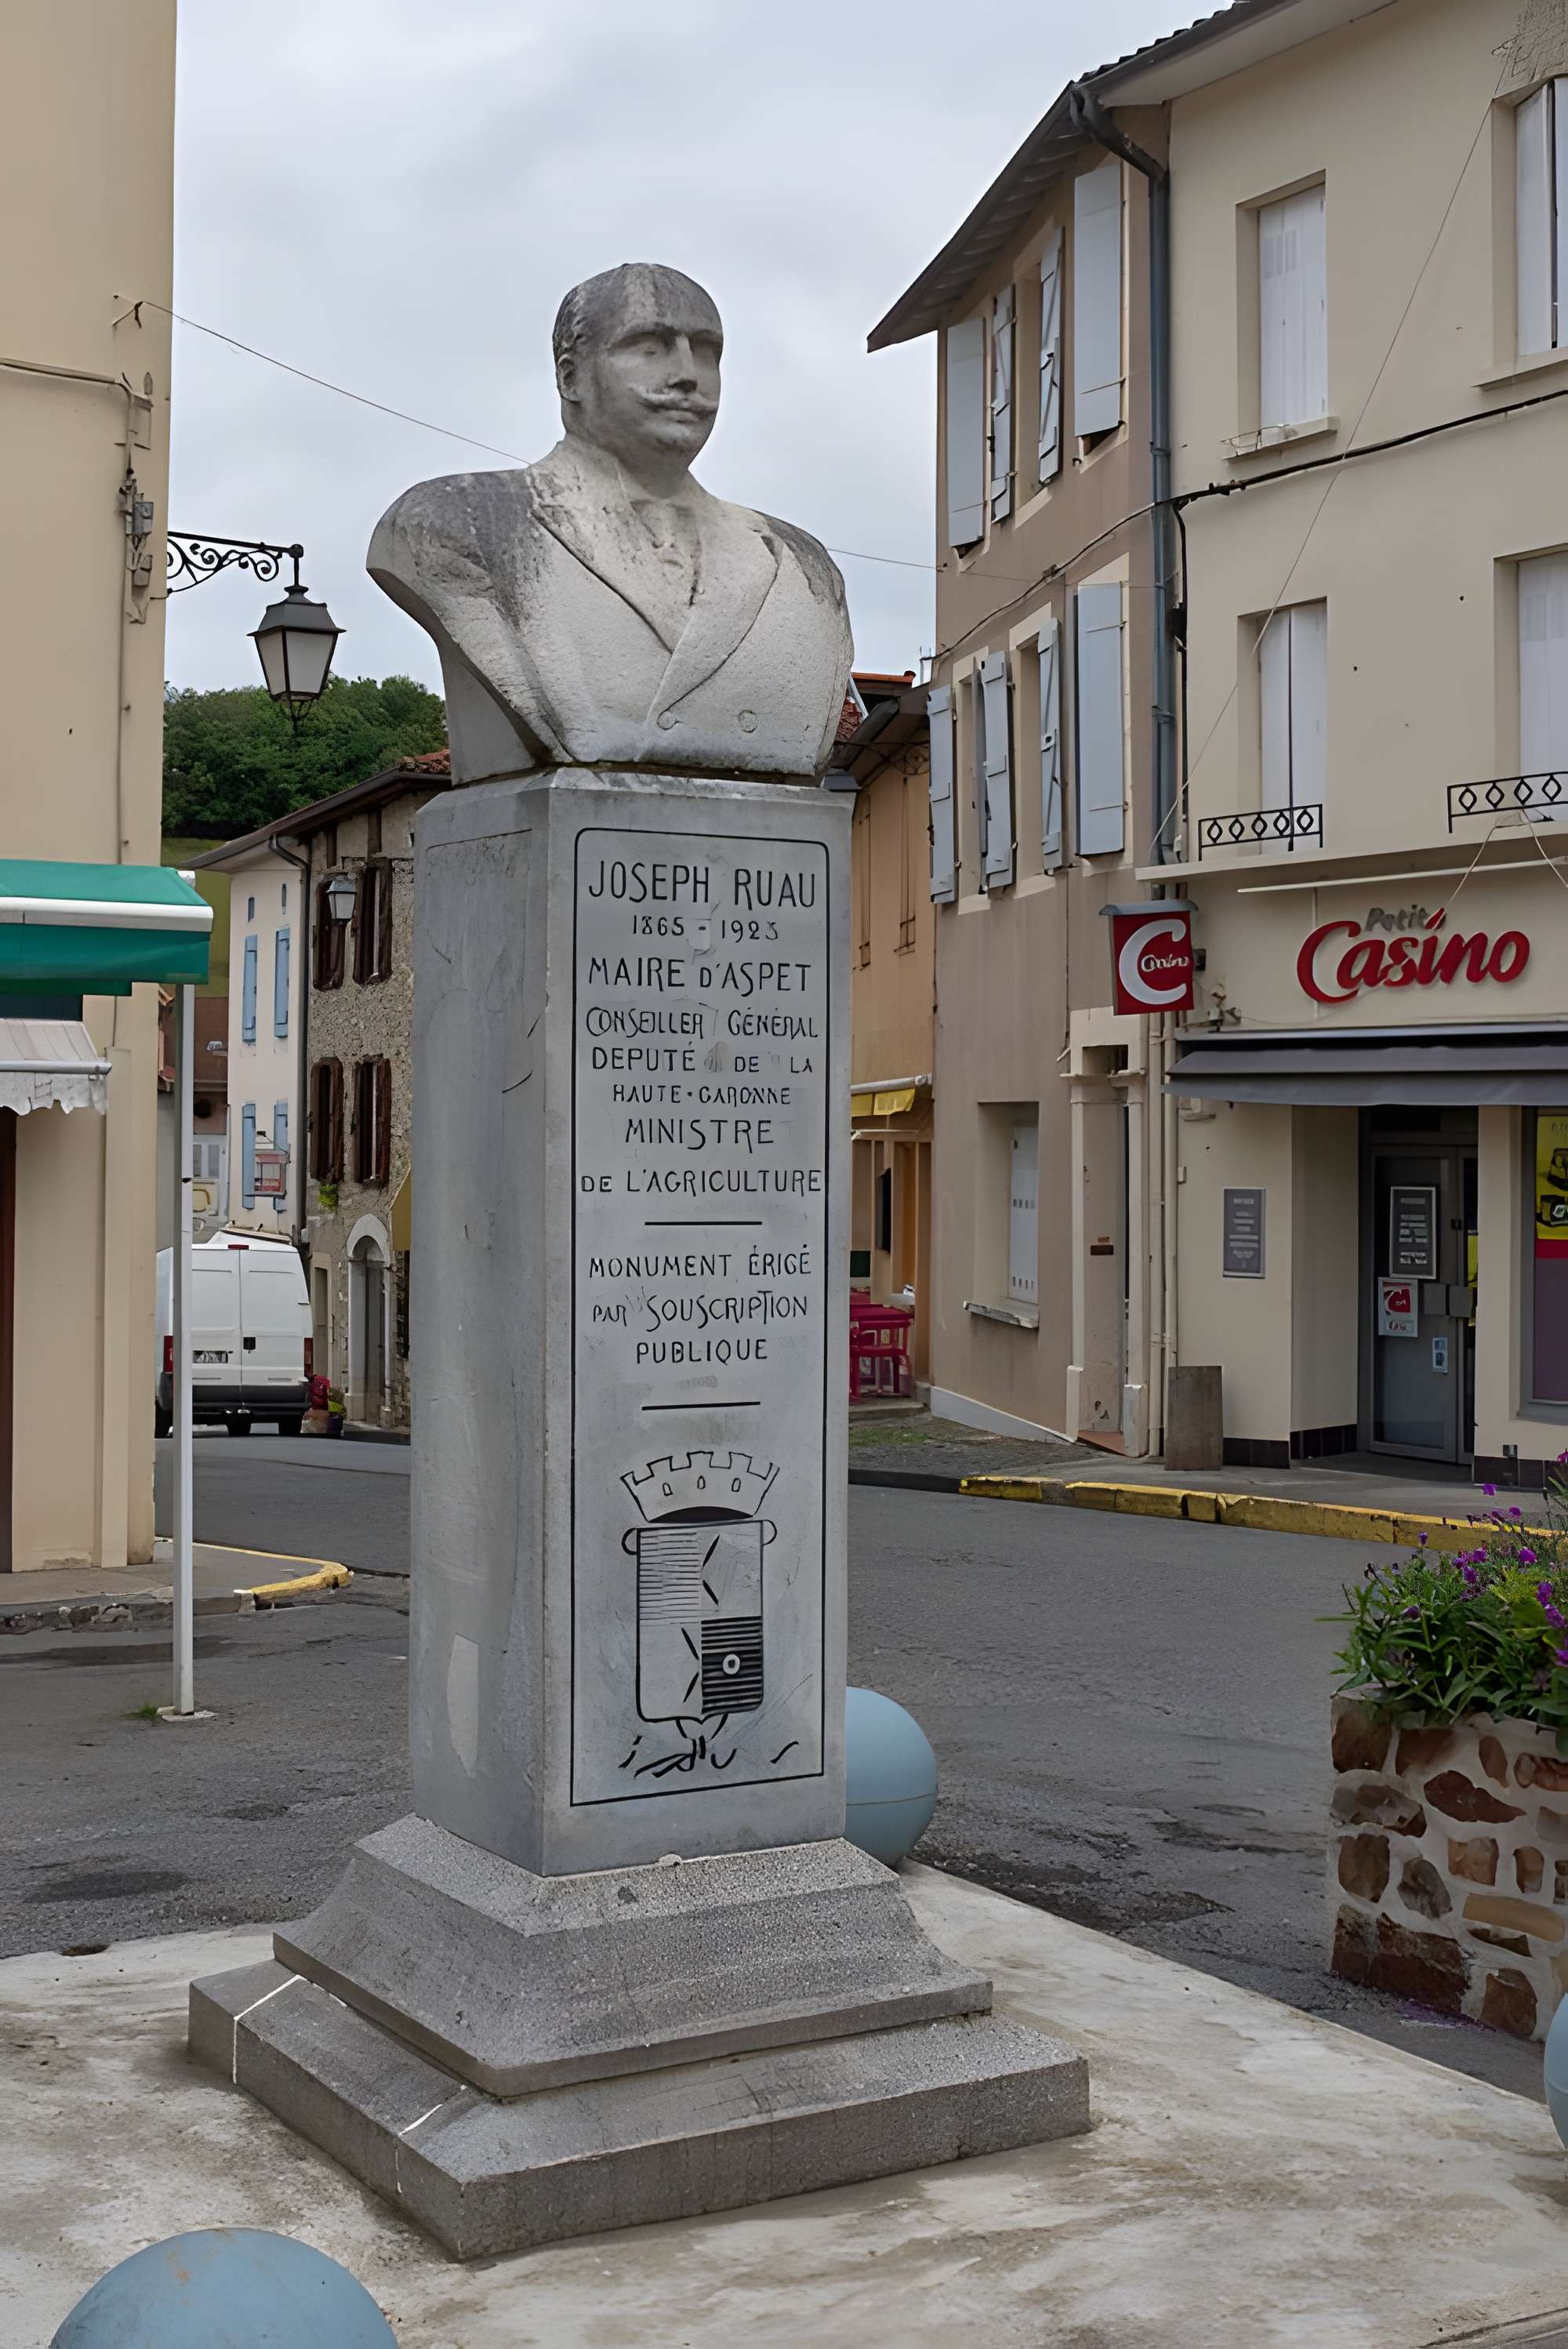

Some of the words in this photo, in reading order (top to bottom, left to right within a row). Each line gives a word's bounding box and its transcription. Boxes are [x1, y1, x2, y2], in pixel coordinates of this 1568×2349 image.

[588, 860, 710, 903] JOSEPH
[734, 868, 815, 911] RUAU
[632, 914, 684, 936] 1865
[1297, 907, 1530, 1004] Casino
[589, 957, 686, 993] MAIRE
[699, 962, 811, 997] D'ASPET
[586, 1006, 705, 1040] CONSEILLER
[734, 1055, 760, 1073] DE
[789, 1055, 814, 1074] LA
[624, 1117, 775, 1154] MINISTRE
[580, 1175, 613, 1193] DE
[626, 1168, 822, 1197] L'AGRICULTURE
[589, 1254, 732, 1279] MONUMENT
[749, 1244, 812, 1278] ÉRIGÉ
[592, 1305, 628, 1327] PAR
[645, 1290, 808, 1332] SOUSCRIPTION
[635, 1338, 768, 1366] PUBLIQUE
